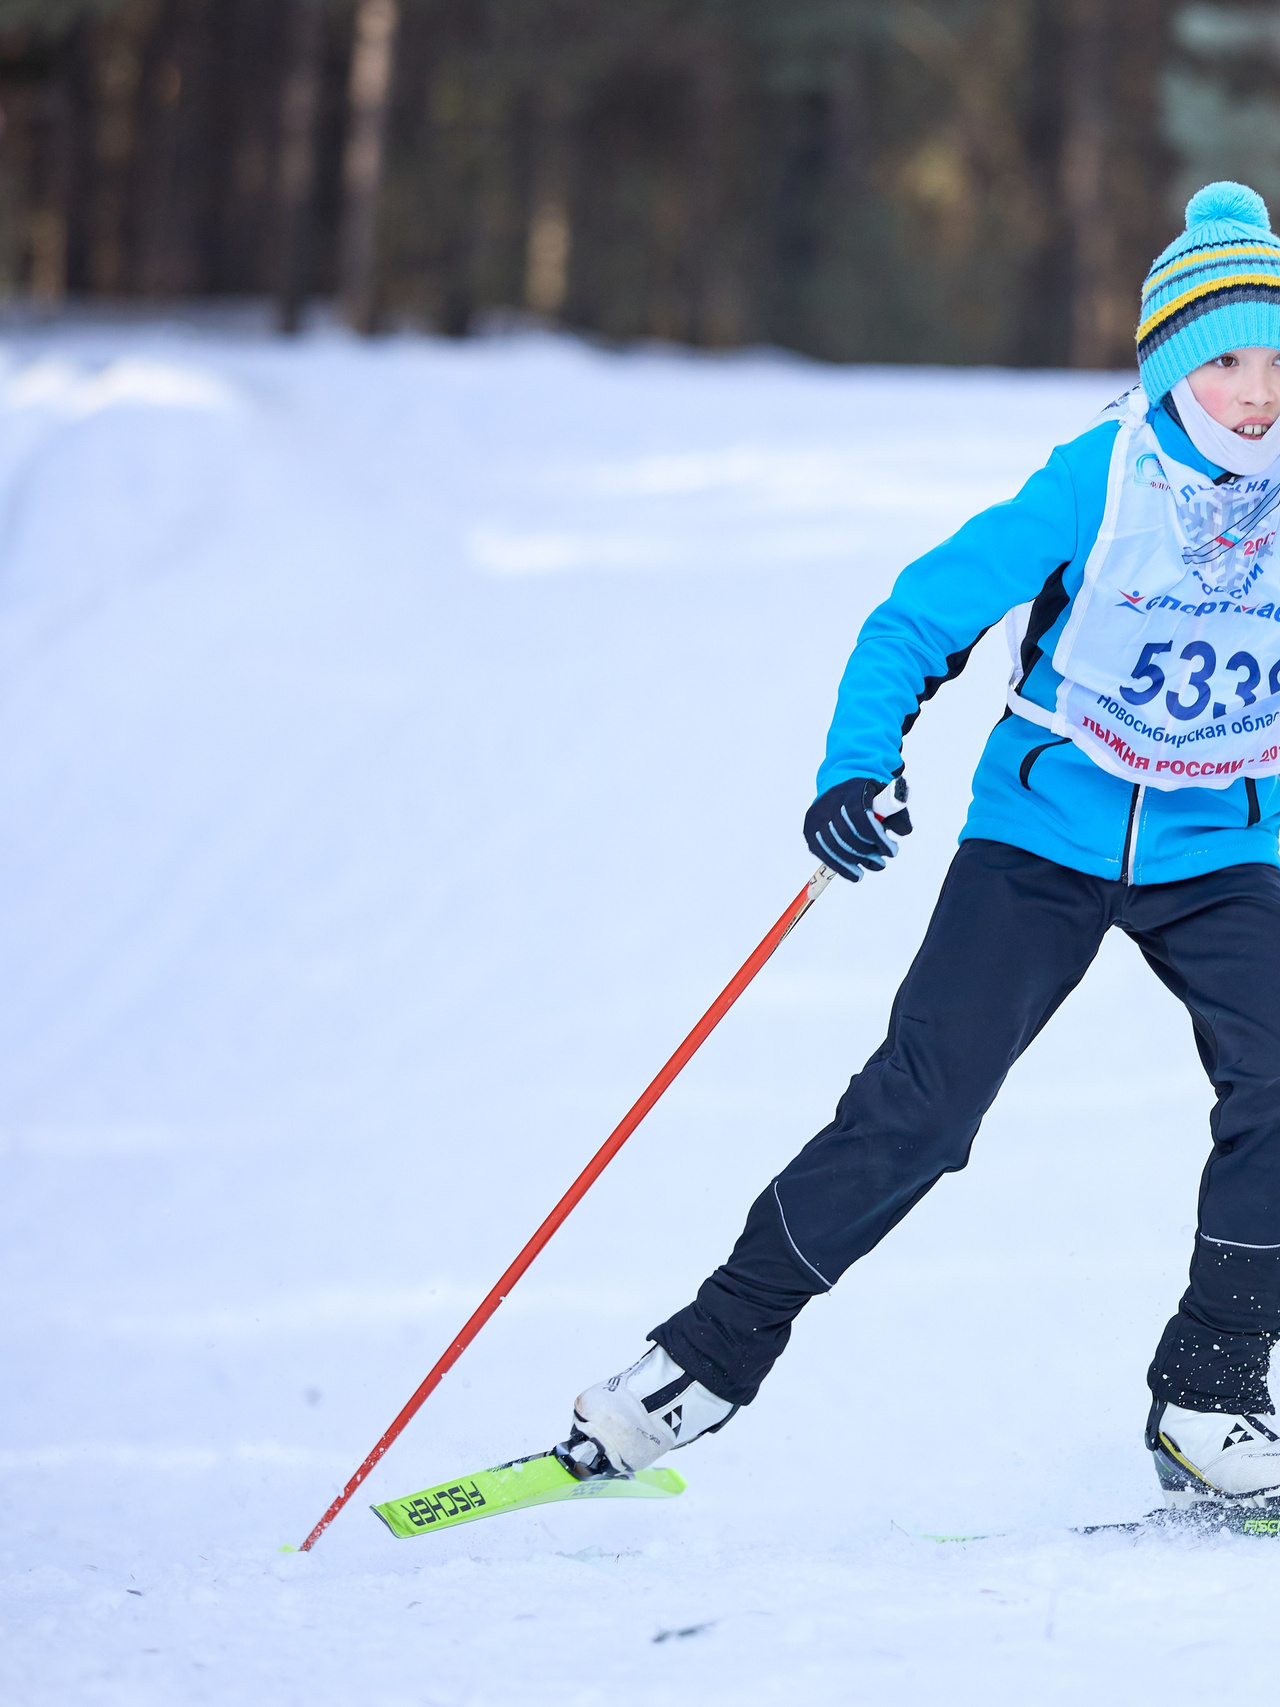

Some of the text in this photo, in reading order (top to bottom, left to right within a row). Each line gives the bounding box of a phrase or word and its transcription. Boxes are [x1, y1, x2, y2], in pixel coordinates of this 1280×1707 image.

[1180, 479, 1270, 503] ЛНЯ
[1082, 716, 1150, 770] ЛЫЖНЯ
[1155, 759, 1245, 778] РОССИИ
[400, 1480, 487, 1527] FISCHER
